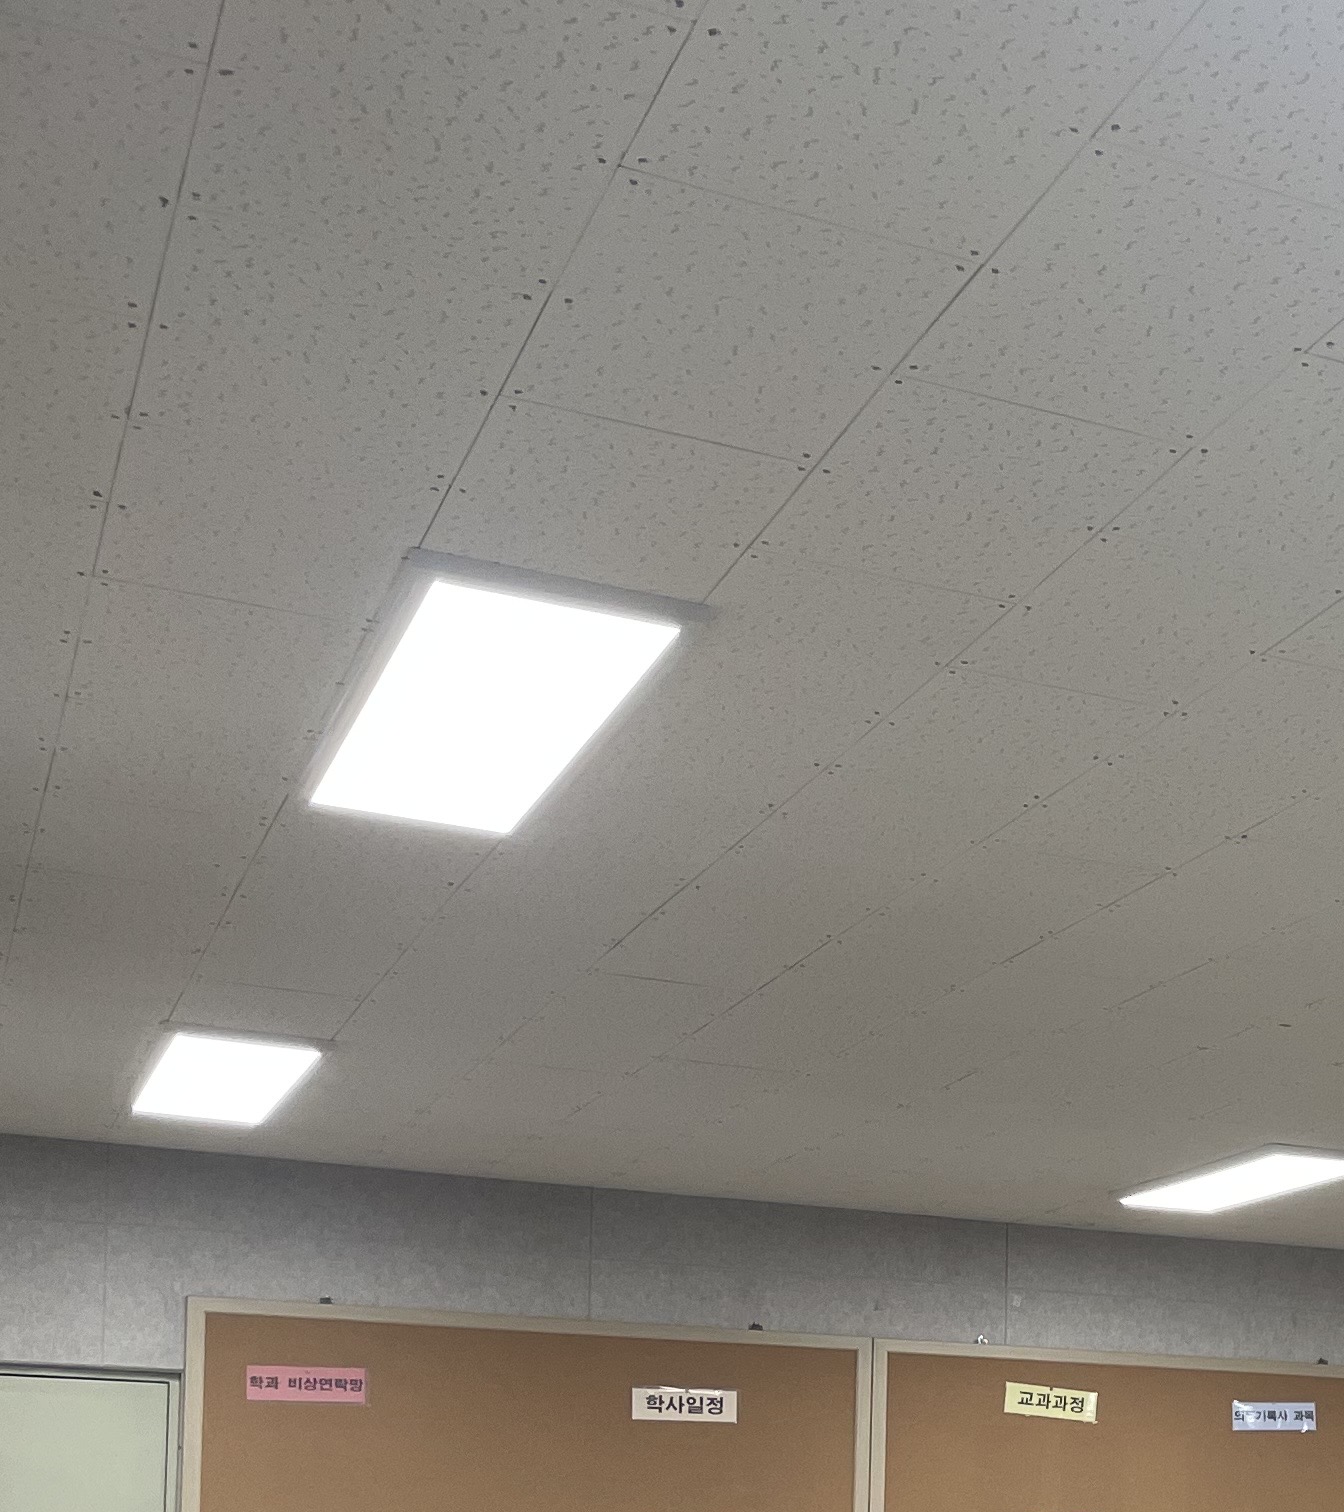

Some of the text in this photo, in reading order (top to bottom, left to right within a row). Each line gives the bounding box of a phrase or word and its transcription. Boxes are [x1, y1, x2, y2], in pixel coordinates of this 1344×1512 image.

[249, 1375, 364, 1393] 학과 비상연락망
[645, 1394, 724, 1416] 학사일정
[1017, 1391, 1085, 1414] 교과과정
[1233, 1409, 1288, 1423] 의기록사
